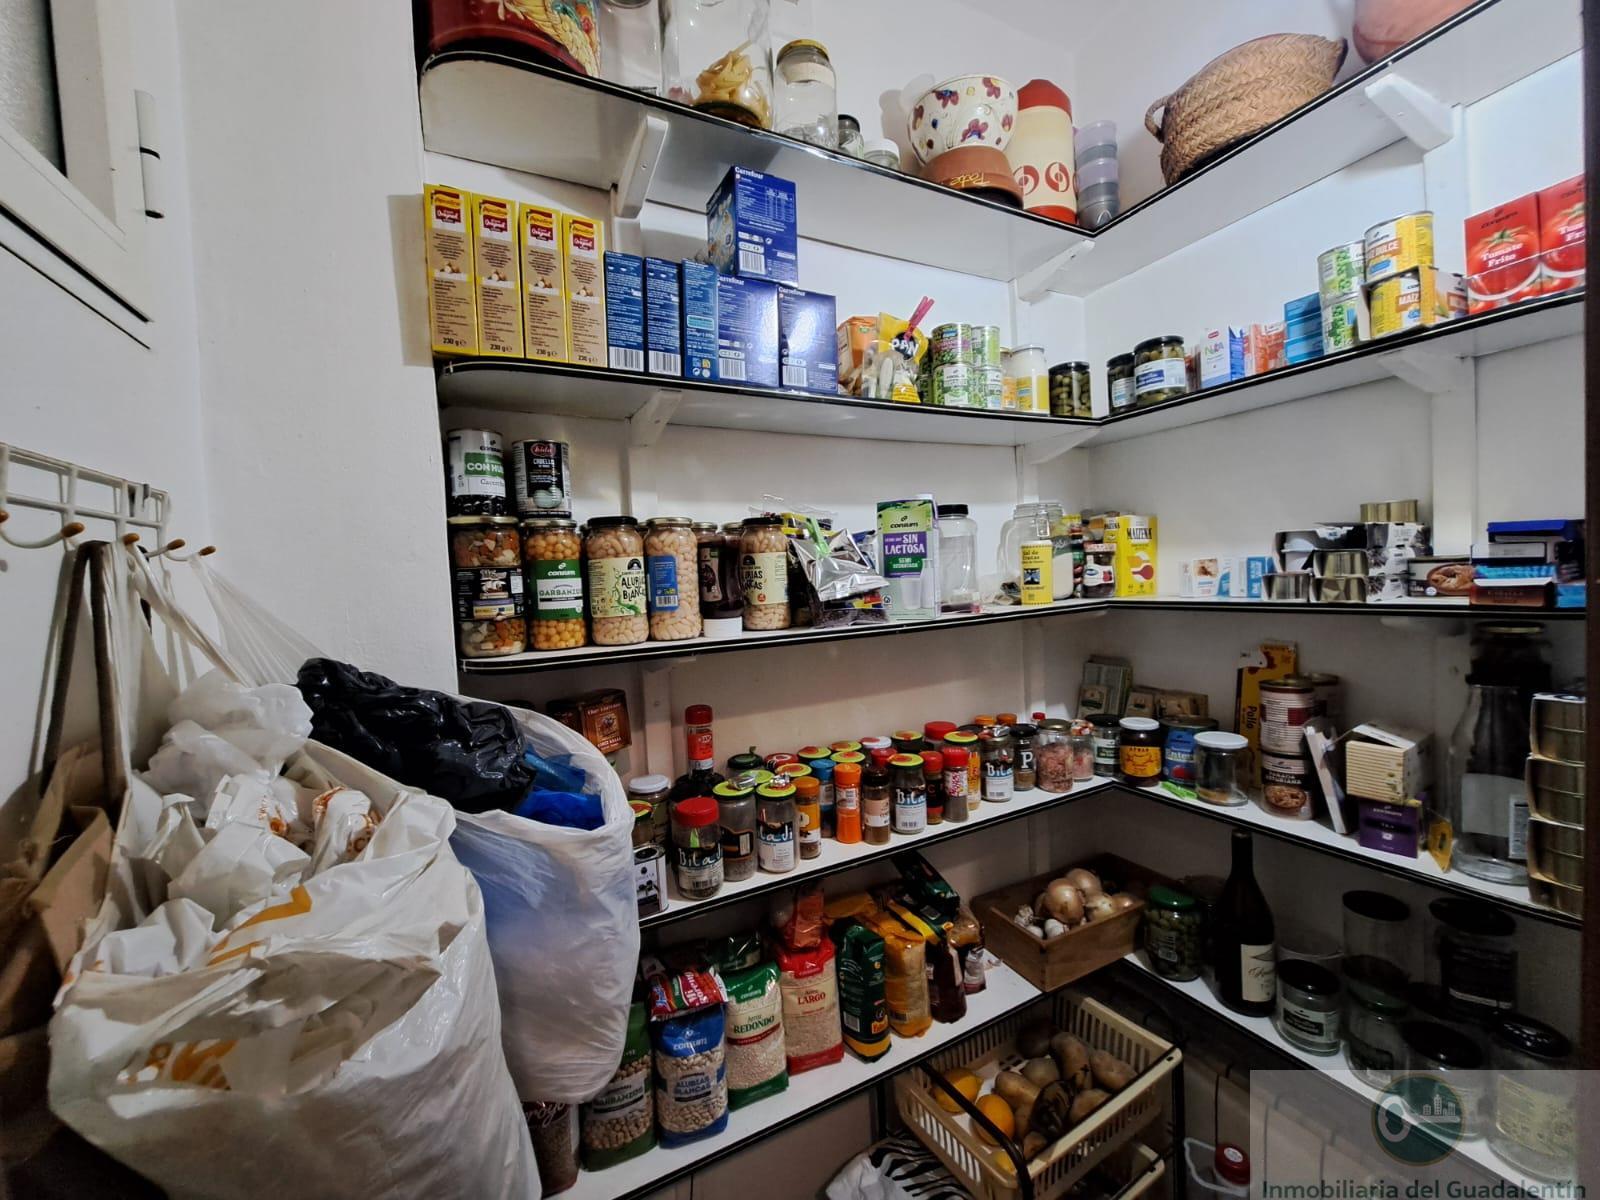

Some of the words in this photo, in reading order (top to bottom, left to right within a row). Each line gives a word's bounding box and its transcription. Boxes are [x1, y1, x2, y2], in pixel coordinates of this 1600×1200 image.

[735, 167, 764, 179] Carrefour
[1482, 243, 1523, 261] Tomate
[1488, 253, 1516, 268] Frito
[718, 275, 745, 286] arrefour
[891, 337, 920, 356] PAN
[466, 462, 490, 474] CON
[902, 534, 918, 544] SIN
[1126, 527, 1152, 540] MAIZENA
[885, 543, 925, 555] LACTOSA
[1247, 705, 1258, 729] Pollo
[797, 991, 826, 1005] LARGO
[734, 1015, 775, 1034] REDONDO
